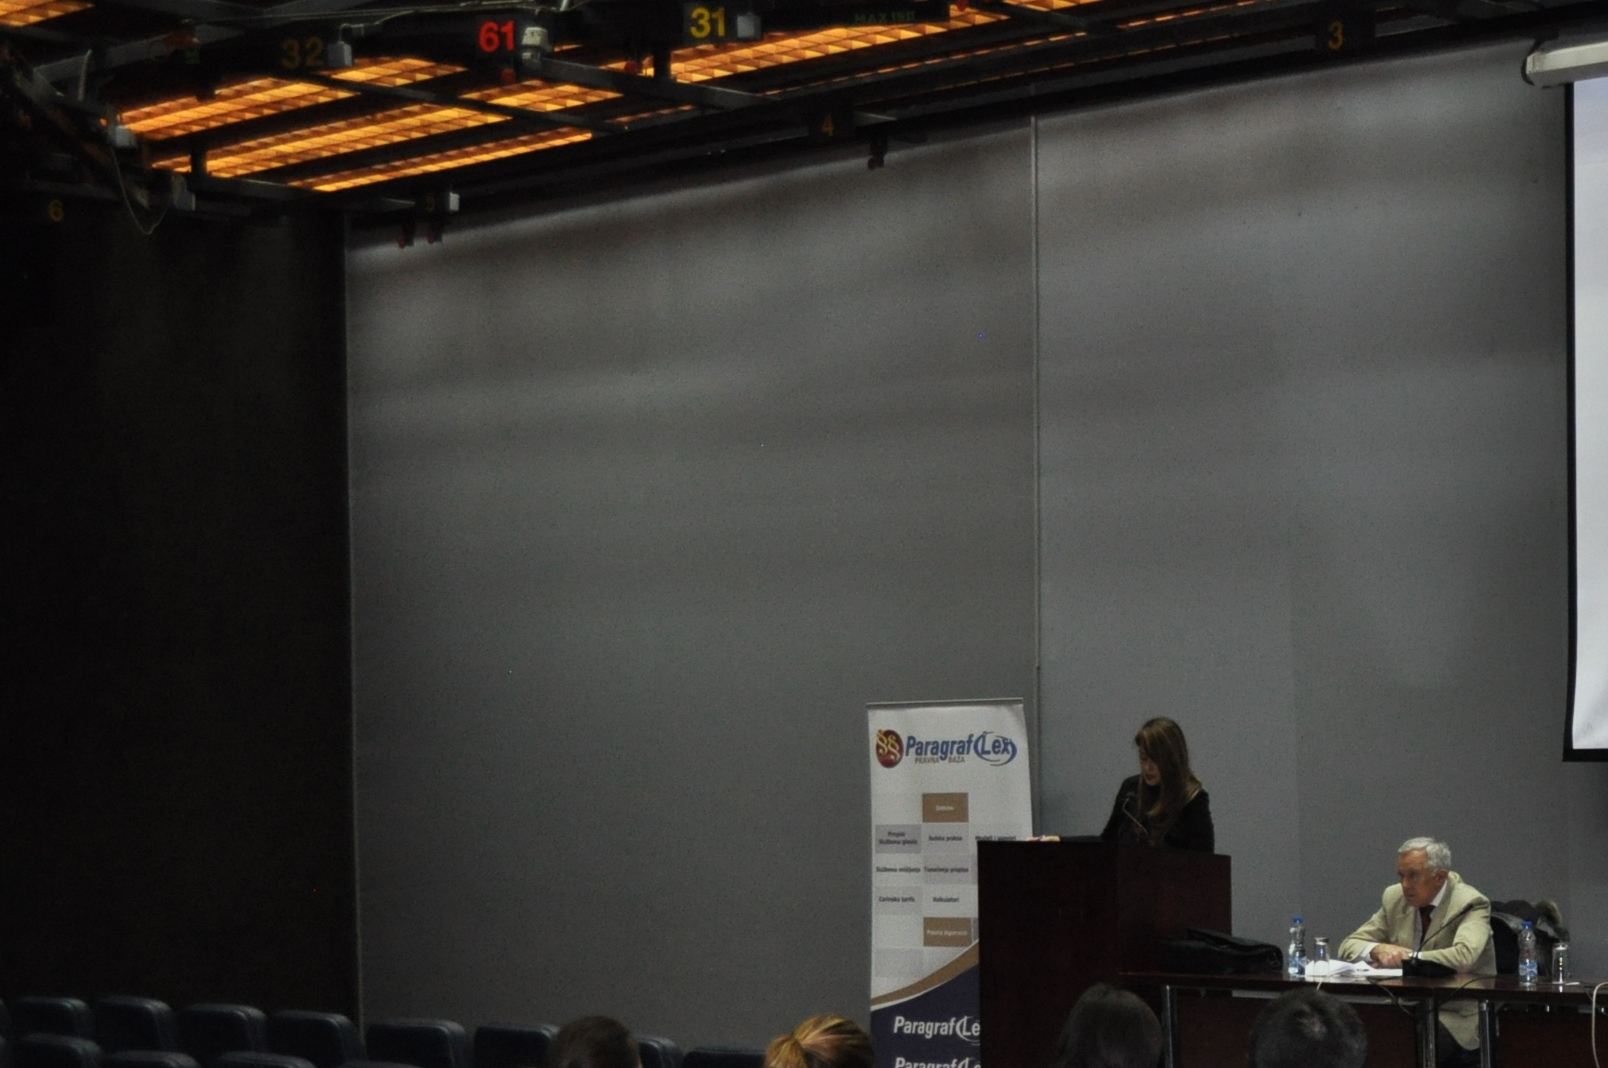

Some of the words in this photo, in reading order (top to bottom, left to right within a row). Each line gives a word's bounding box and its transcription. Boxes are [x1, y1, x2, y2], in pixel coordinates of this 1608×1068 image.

[480, 21, 515, 52] 61
[690, 7, 727, 38] 31
[1328, 20, 1345, 50] 3
[282, 36, 325, 69] 32
[821, 113, 835, 136] 4
[47, 198, 64, 223] 6
[905, 733, 974, 761] Paragraf
[893, 1016, 957, 1039] Paragraf
